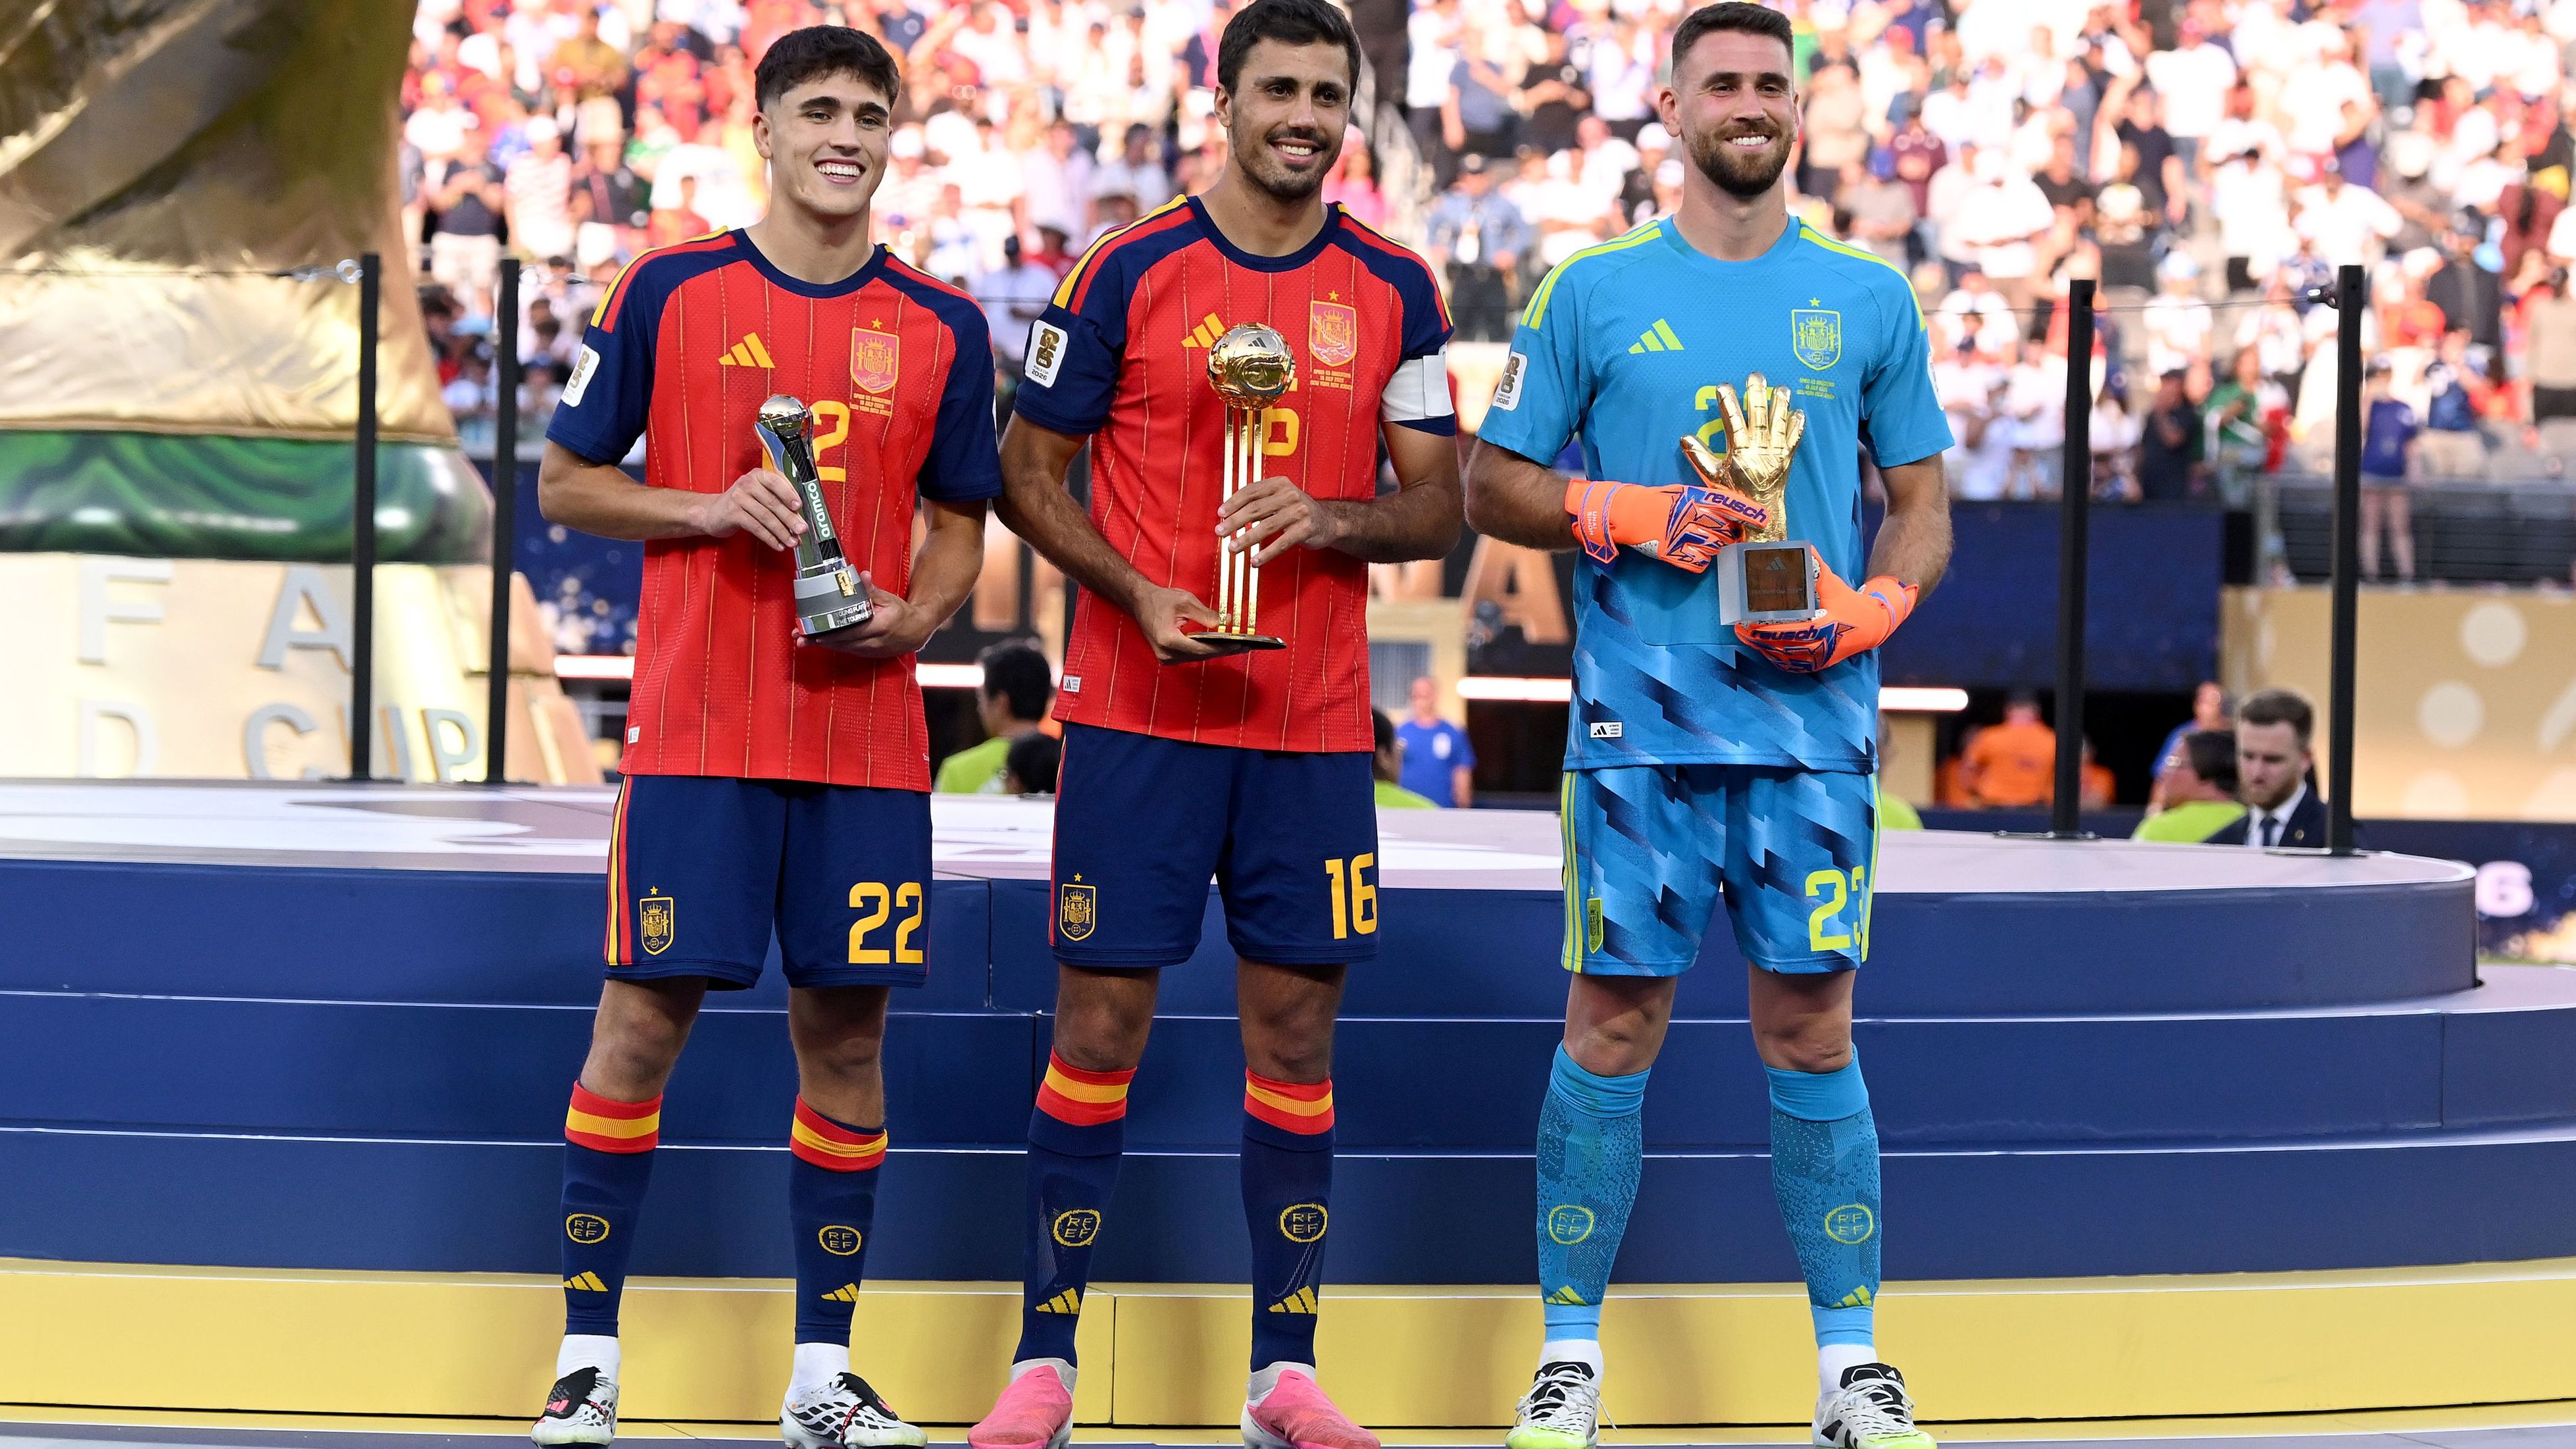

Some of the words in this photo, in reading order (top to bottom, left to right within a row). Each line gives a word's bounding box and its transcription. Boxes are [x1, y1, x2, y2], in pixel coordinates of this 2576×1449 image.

[1031, 369, 1048, 380] 2026
[808, 482, 830, 538] aramco
[1704, 492, 1767, 523] reusch
[837, 618, 847, 626] THE
[1325, 852, 1378, 940] 16
[848, 881, 924, 964] 22
